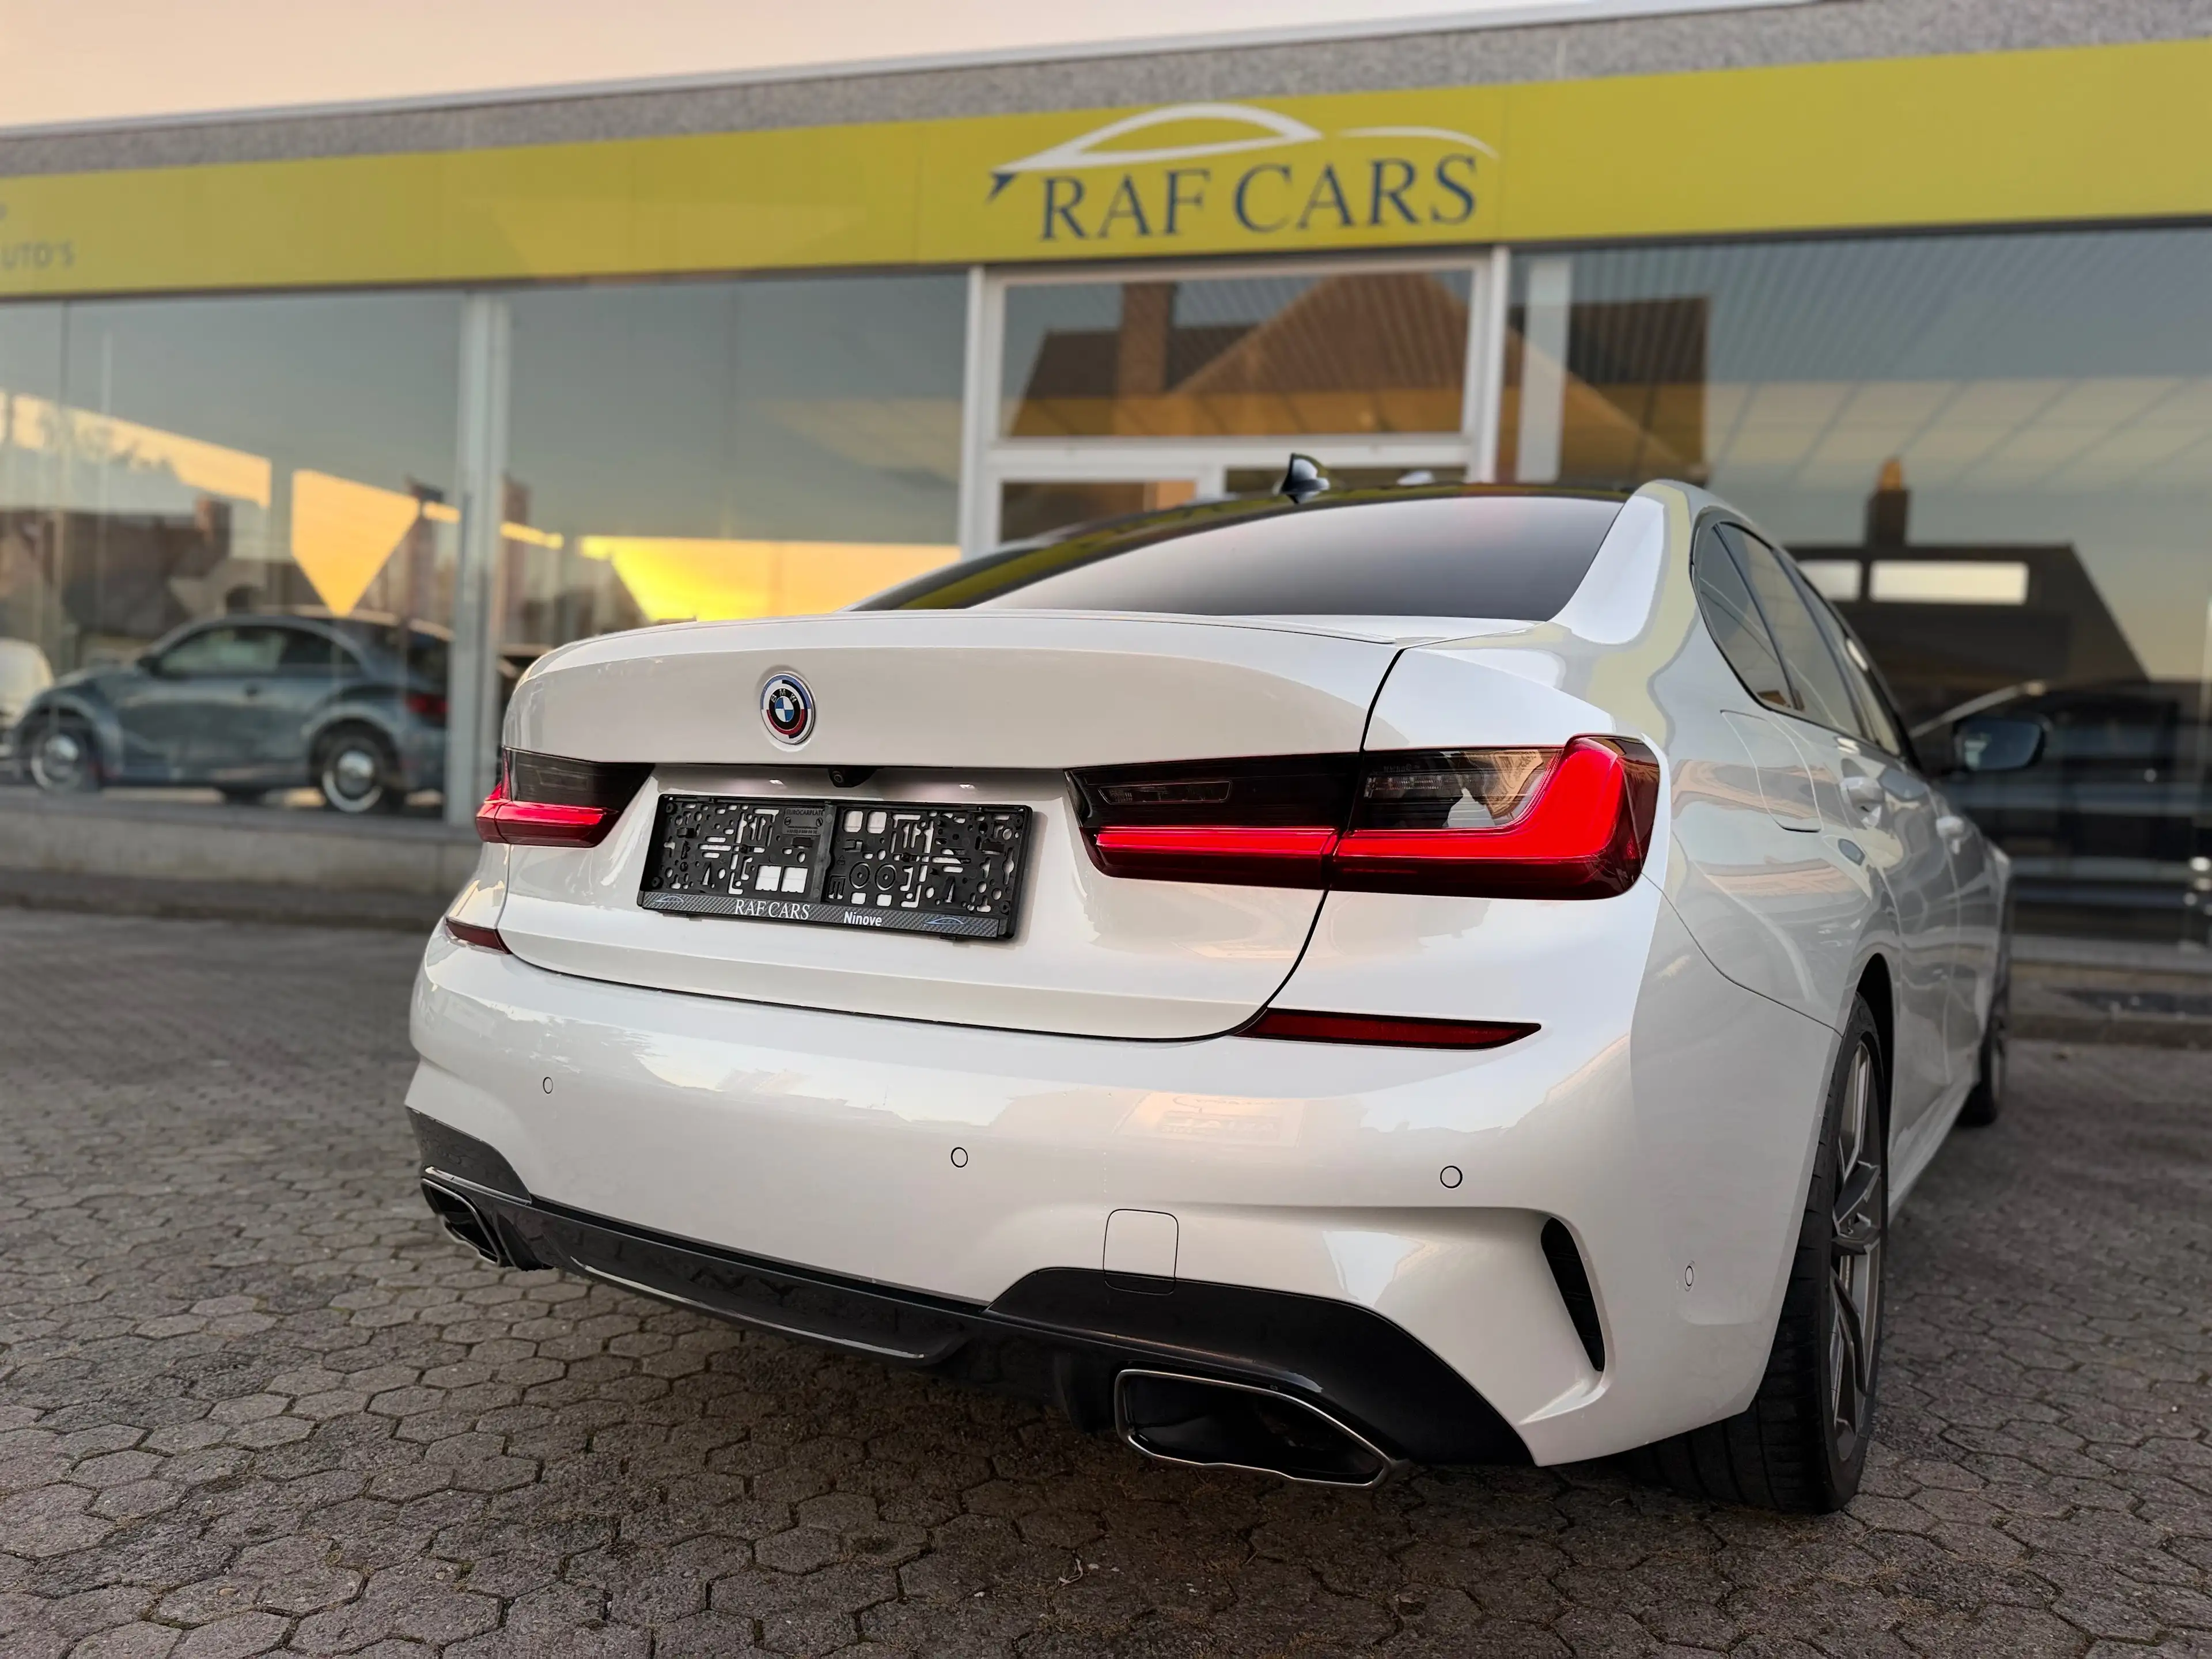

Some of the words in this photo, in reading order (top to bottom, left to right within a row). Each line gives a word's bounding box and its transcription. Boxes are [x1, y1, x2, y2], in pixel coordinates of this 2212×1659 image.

[1039, 168, 1211, 241] RAF
[1232, 153, 1479, 233] CARS
[771, 688, 797, 703] BMW
[734, 899, 767, 916] RAF
[768, 902, 810, 921] CARS
[843, 911, 882, 926] Ninove
